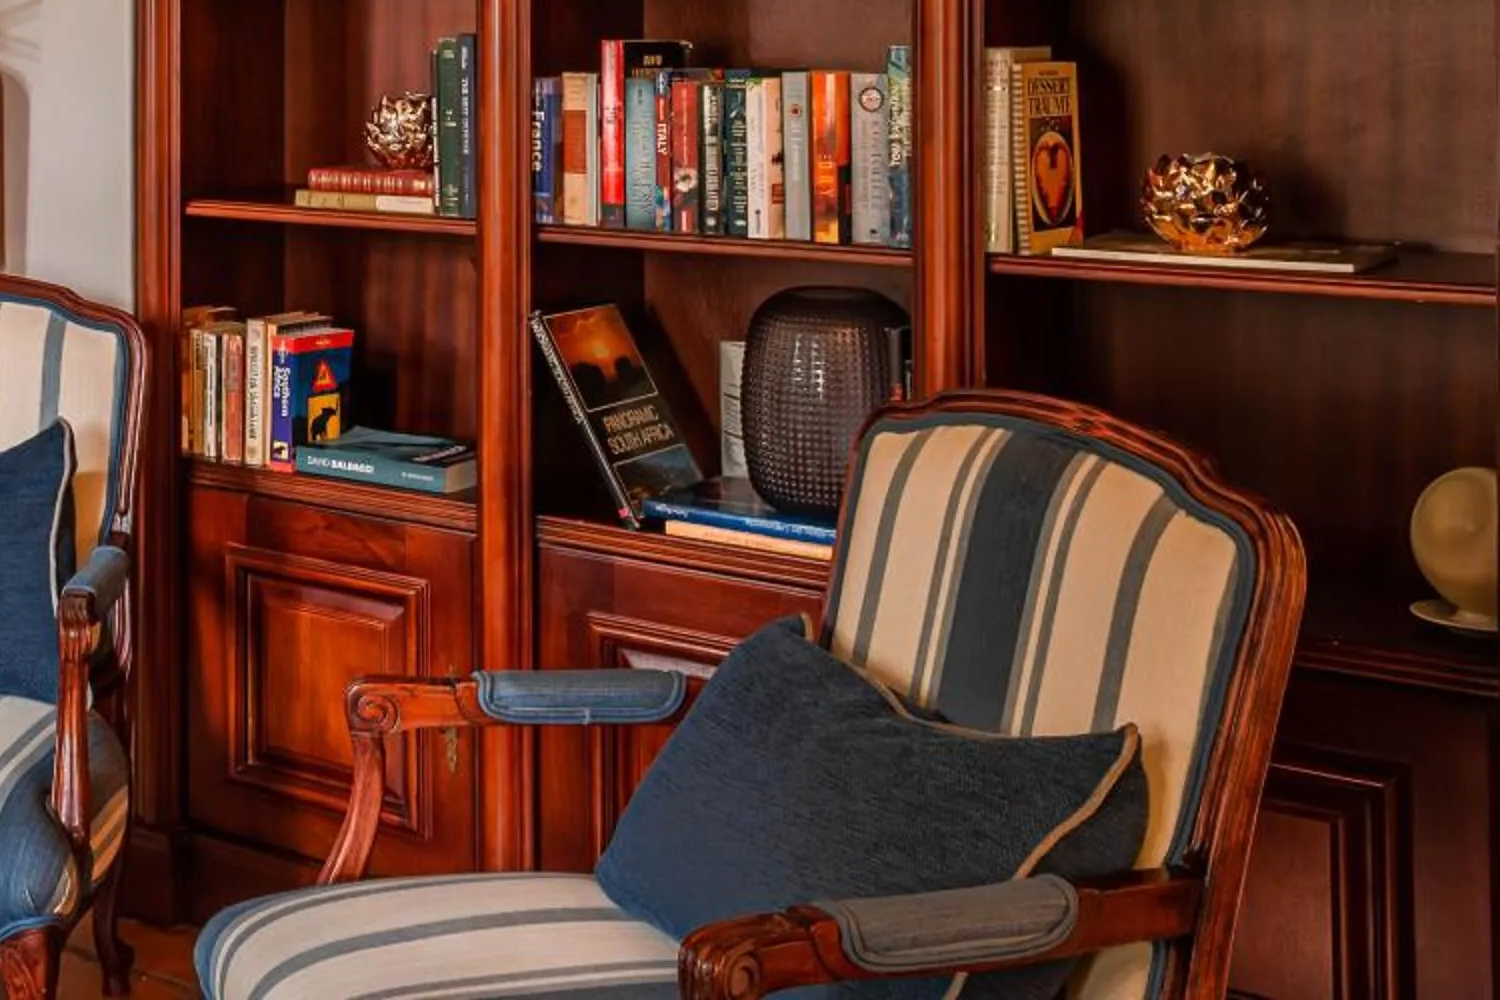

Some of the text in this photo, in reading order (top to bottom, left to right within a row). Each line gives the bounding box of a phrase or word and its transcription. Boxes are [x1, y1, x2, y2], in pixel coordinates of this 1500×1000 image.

[531, 111, 546, 172] France
[656, 123, 669, 155] ITALY
[273, 365, 282, 399] Africa
[281, 366, 291, 417] Southern
[603, 405, 659, 432] PANORAMIC
[608, 423, 675, 455] SOUTH AFRICA
[307, 455, 330, 468] DAVID
